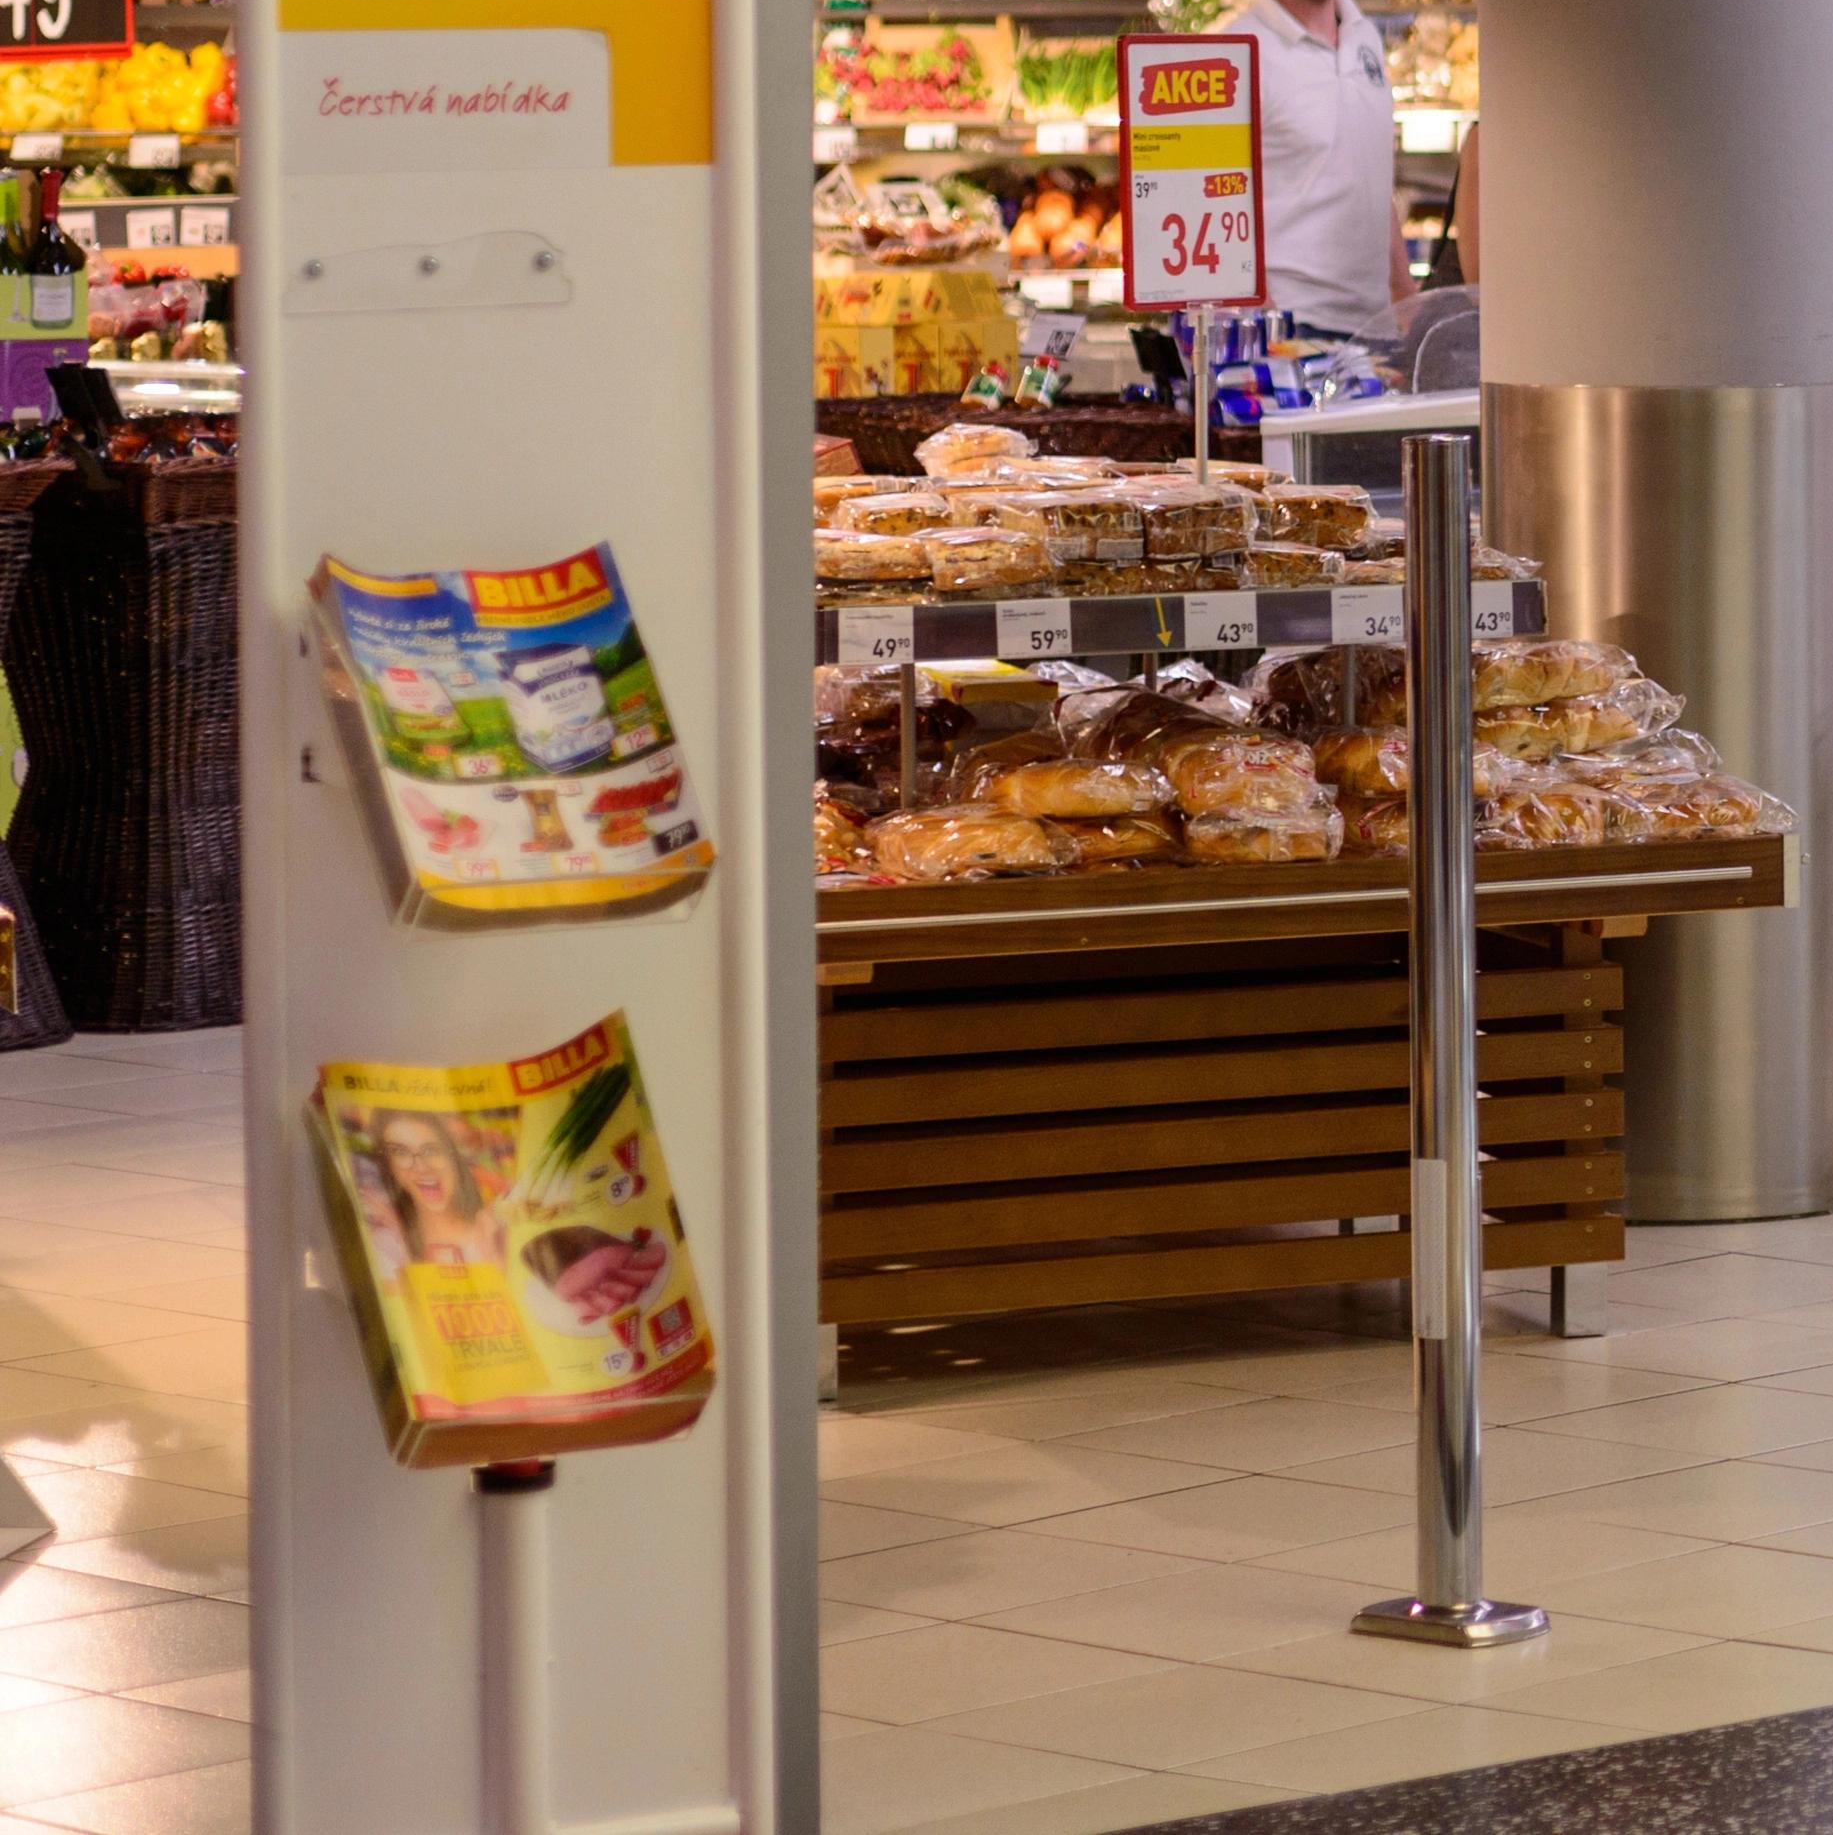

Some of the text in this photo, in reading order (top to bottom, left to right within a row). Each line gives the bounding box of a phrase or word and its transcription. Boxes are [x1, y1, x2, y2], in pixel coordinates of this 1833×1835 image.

[319, 78, 571, 117] Čerstvá nabídka
[1151, 69, 1228, 105] AKCE
[1207, 175, 1245, 196] -13%
[472, 560, 600, 610] BILLA
[517, 1033, 605, 1089] BILLA
